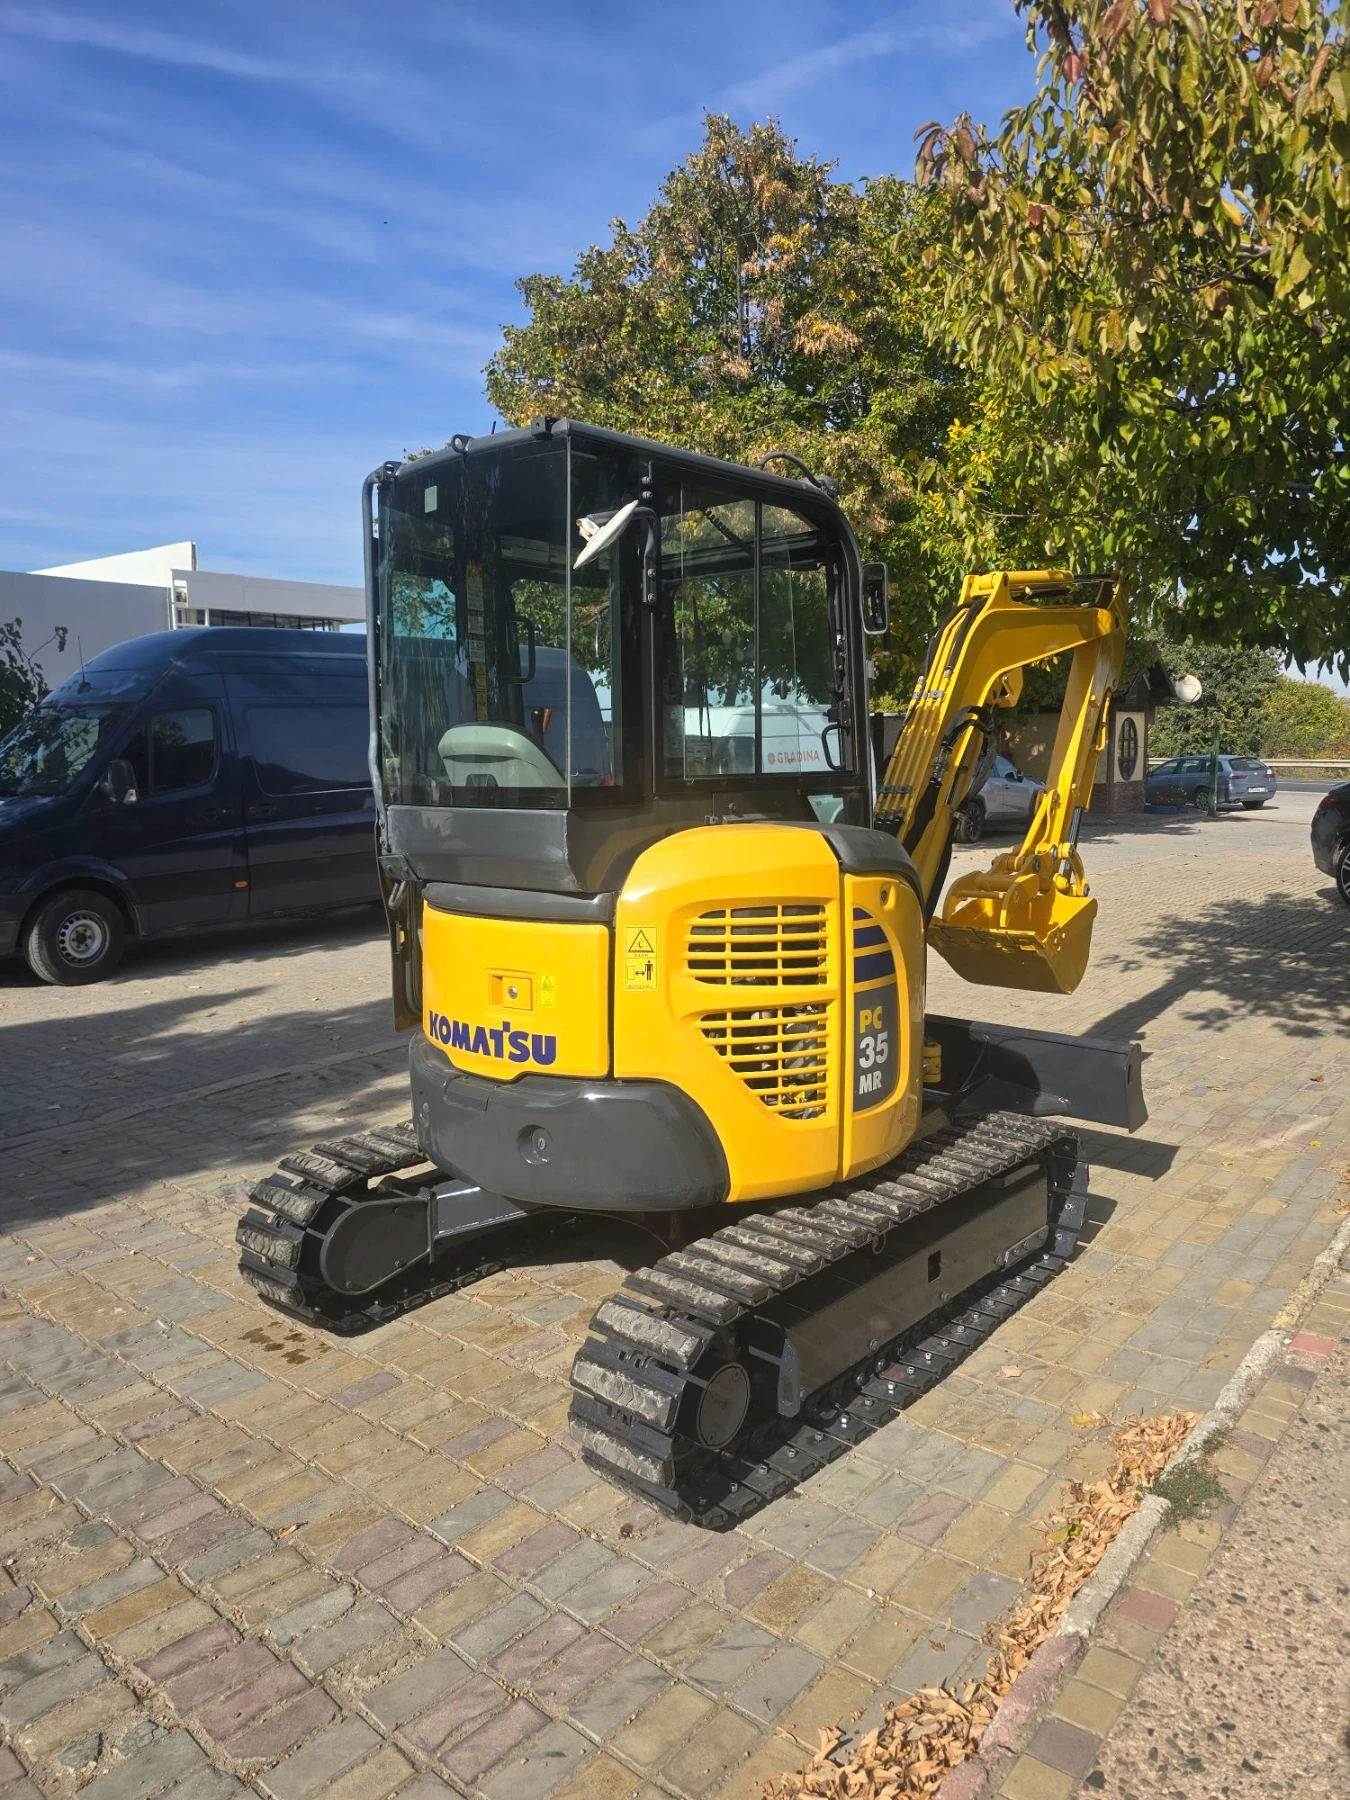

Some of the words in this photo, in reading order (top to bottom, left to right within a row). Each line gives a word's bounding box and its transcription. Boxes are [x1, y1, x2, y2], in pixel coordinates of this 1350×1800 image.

[777, 750, 819, 764] GRADINA
[859, 1005, 883, 1034] PC
[429, 1010, 557, 1066] KOMATSU
[859, 1031, 888, 1069] 35
[858, 1070, 882, 1095] MR
